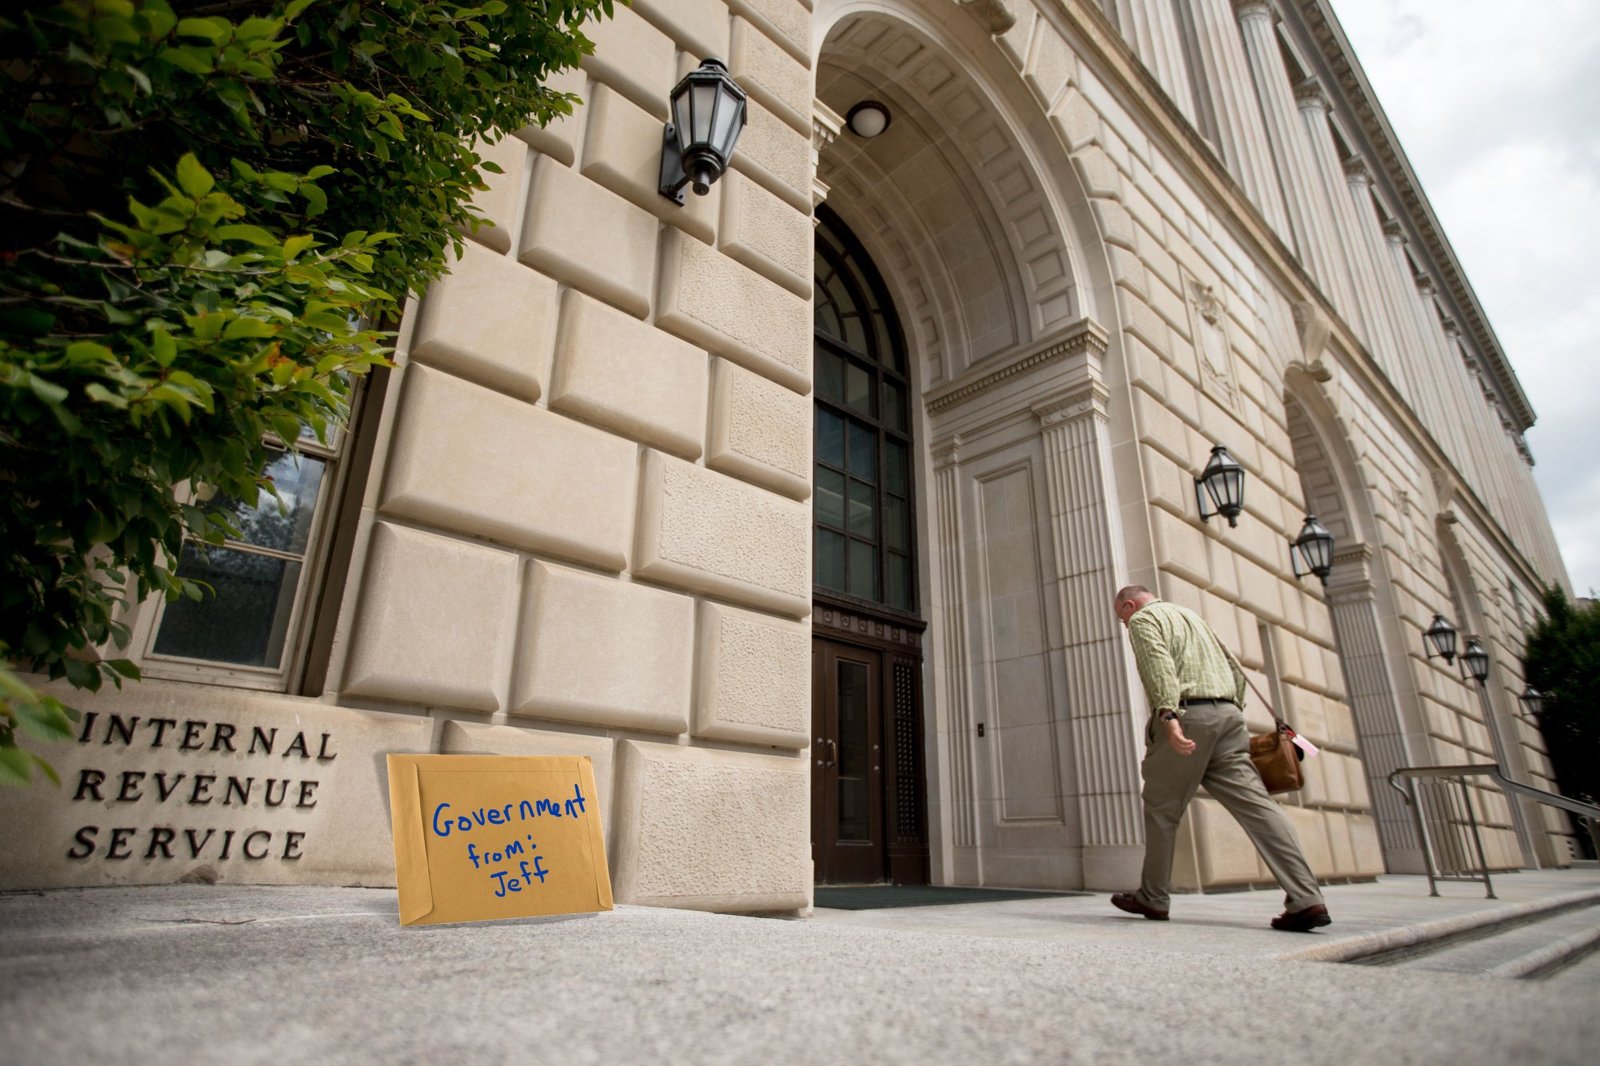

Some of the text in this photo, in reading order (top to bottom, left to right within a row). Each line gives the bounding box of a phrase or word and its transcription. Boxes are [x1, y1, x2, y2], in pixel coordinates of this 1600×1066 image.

[79, 712, 337, 760] INTERNAL
[73, 769, 319, 808] REVENUE
[433, 784, 585, 837] Government
[69, 826, 306, 860] SERVICE
[468, 834, 537, 869] from:
[490, 856, 549, 898] Jeff
